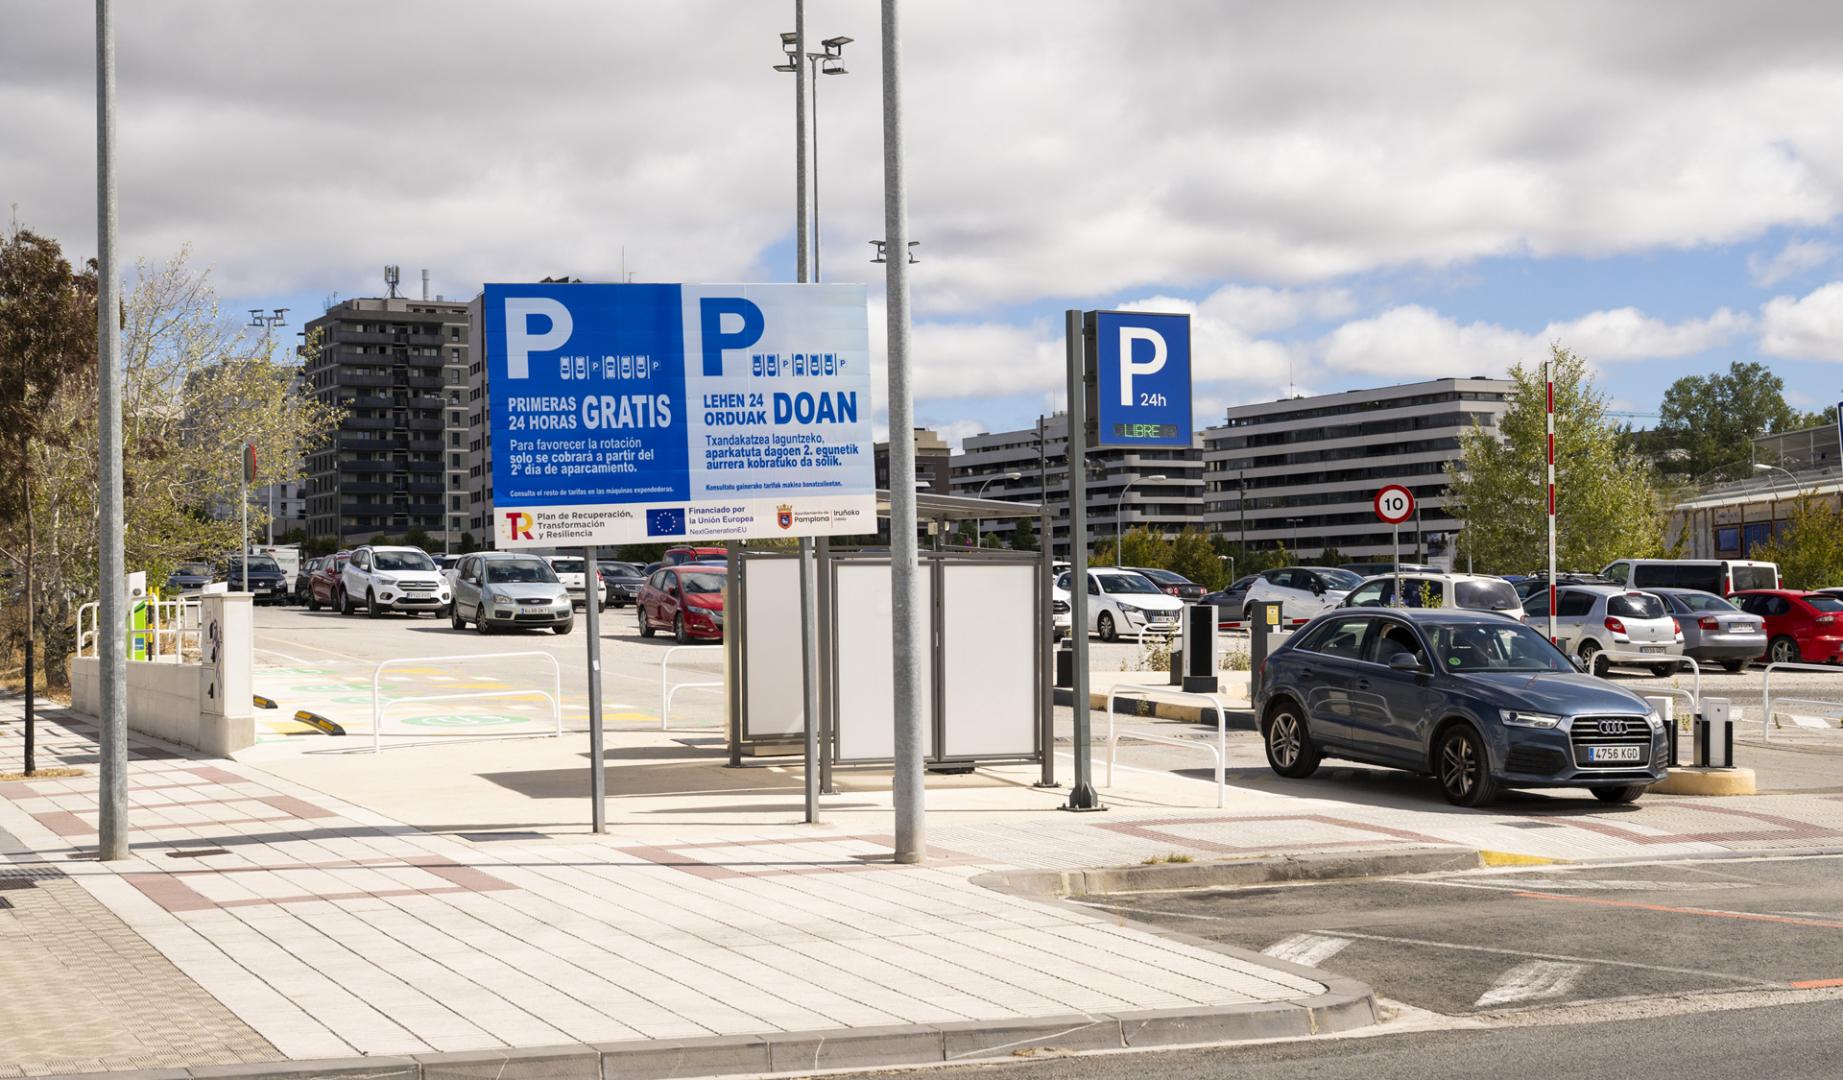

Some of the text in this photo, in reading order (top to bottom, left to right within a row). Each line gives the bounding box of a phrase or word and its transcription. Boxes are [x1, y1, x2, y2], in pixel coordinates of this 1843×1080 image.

[505, 298, 573, 379] P
[700, 298, 764, 376] P
[1120, 326, 1167, 406] P
[508, 397, 576, 412] PRIMERAS
[704, 393, 763, 408] LEHEN 24
[1140, 393, 1166, 406] 24h
[582, 394, 671, 429] GRATIS
[774, 392, 857, 424] DOAN
[508, 415, 576, 430] 24 HORAS
[704, 411, 767, 426] ORDUAK
[1125, 424, 1160, 438] LIBRE
[510, 437, 641, 450] Para favorecer la rotación
[705, 433, 824, 446] Txandakatzea laguntzeko,
[510, 452, 532, 463] solo
[536, 455, 548, 463] se
[551, 451, 593, 462] cobrará
[606, 450, 635, 464] partir
[638, 449, 654, 460] del
[706, 444, 859, 460] aparkatuta dagoen 2. egunetik
[544, 463, 557, 474] de
[561, 462, 637, 476] aparcamiento.
[707, 460, 744, 470] aurrera
[748, 458, 798, 469] kobratuko
[801, 457, 812, 467] da
[1385, 498, 1403, 511] 10
[572, 510, 633, 520] Recuperación,
[698, 515, 720, 524] Unión
[723, 514, 754, 525] Europea
[538, 520, 605, 529] Transformación
[690, 527, 747, 535] NextGenerationEU
[1596, 748, 1638, 759] 4756 KGD
